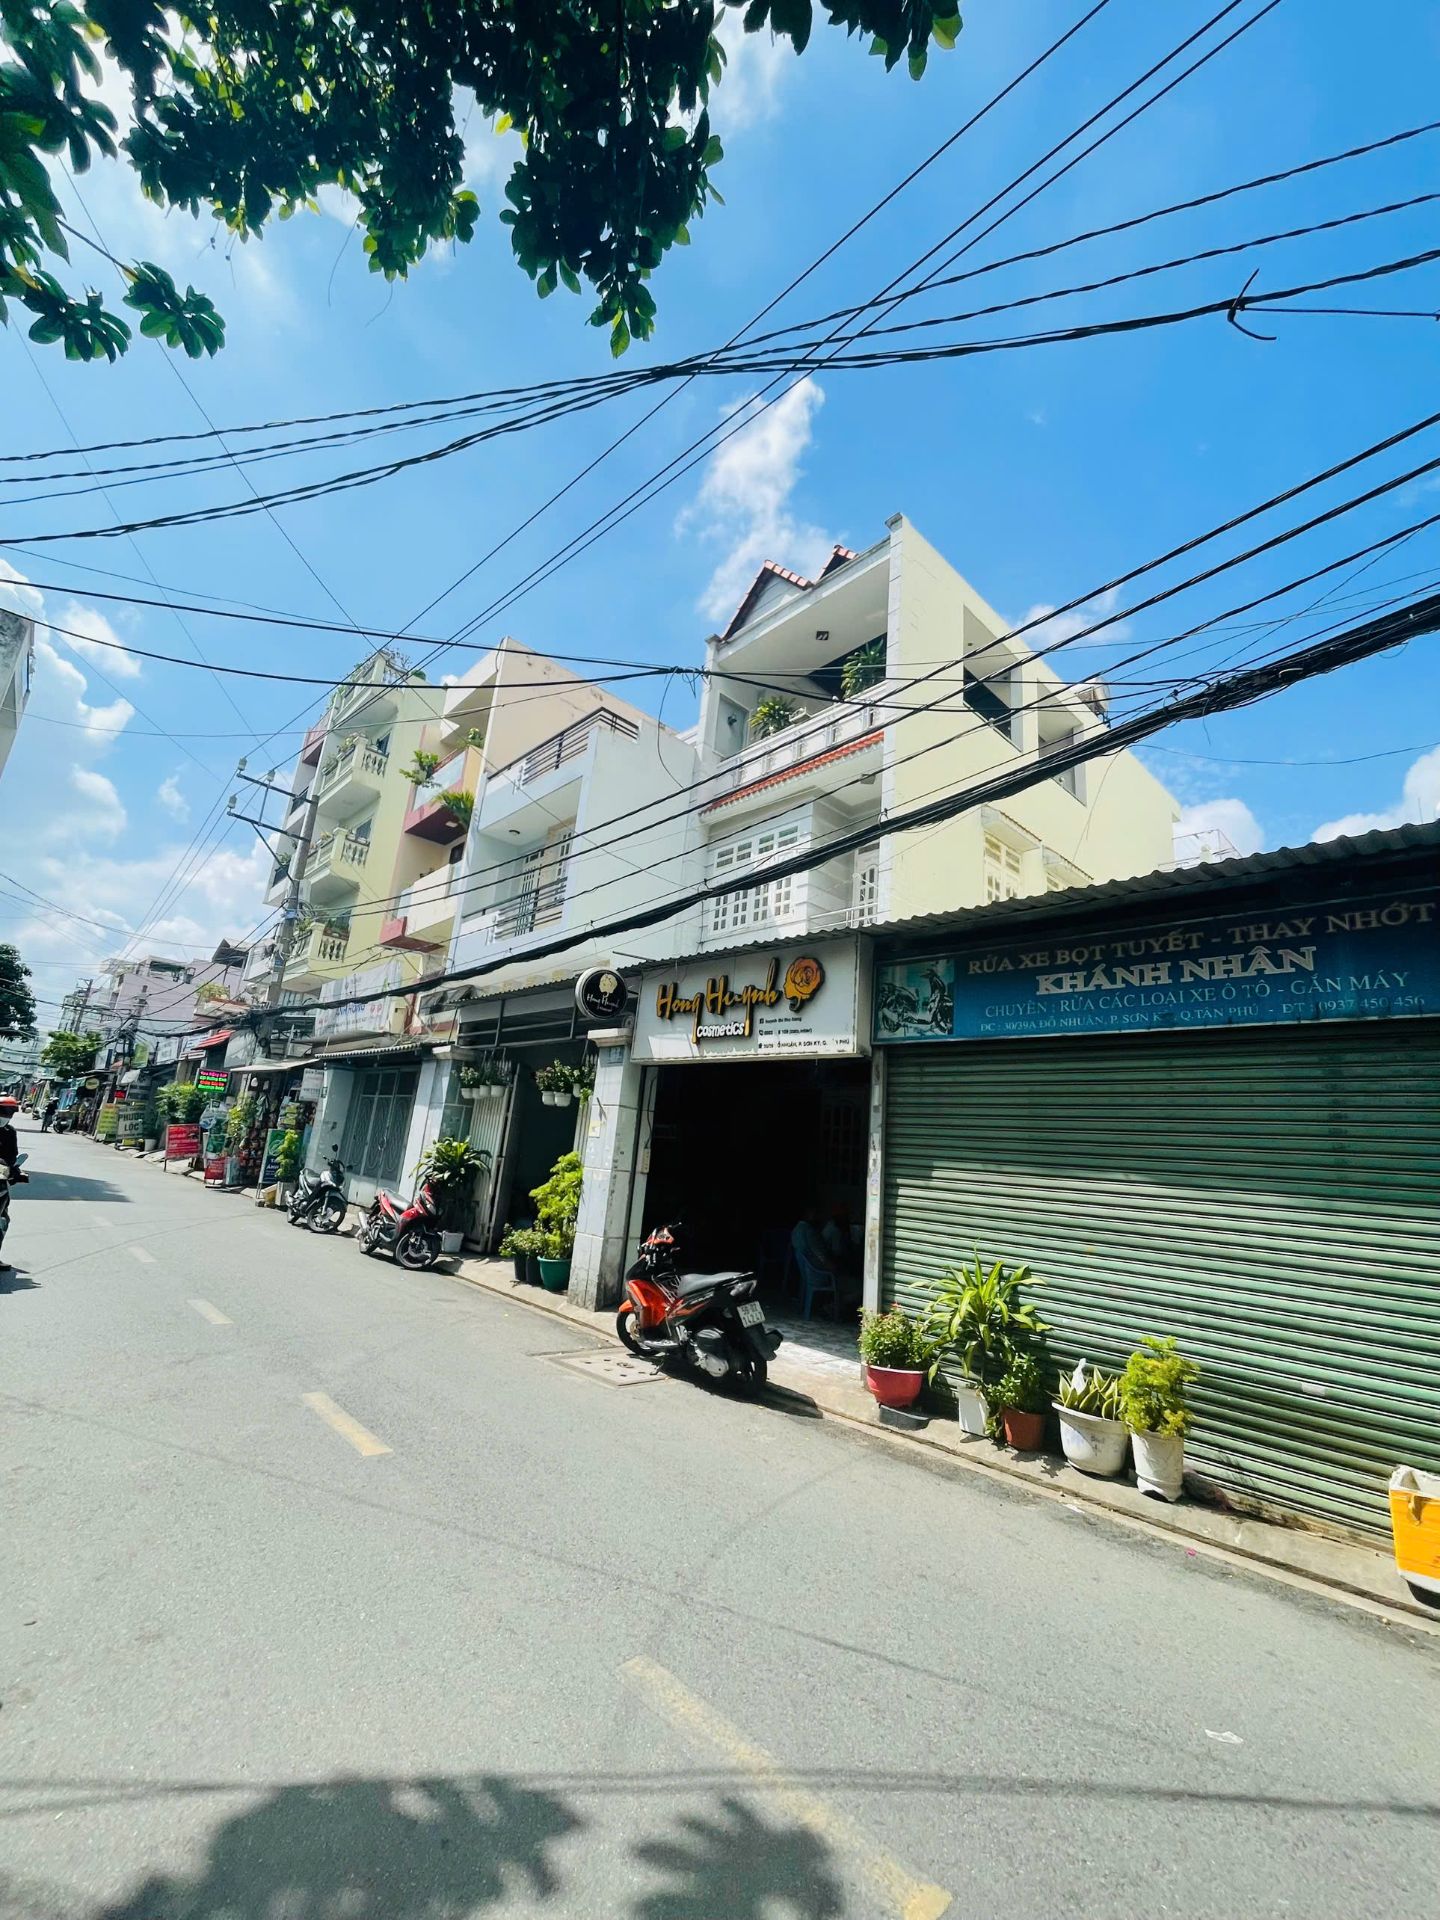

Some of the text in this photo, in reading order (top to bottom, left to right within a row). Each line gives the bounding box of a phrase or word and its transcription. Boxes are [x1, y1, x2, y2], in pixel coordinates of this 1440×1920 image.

[1019, 952, 1051, 969] XE
[1055, 945, 1107, 966] BỌT
[1110, 928, 1204, 958] TUYẾT
[1227, 916, 1317, 945] THAY
[1324, 901, 1437, 933] NHỚT
[985, 1000, 1048, 1018] CHUYÊN
[1060, 994, 1094, 1013] RỬA
[1099, 991, 1136, 1009] CÁC
[1140, 989, 1184, 1007] LOẠI
[1190, 986, 1217, 1003] XE
[1222, 982, 1236, 1000] Ô
[1241, 979, 1271, 999] TÔ
[1350, 968, 1410, 992] MÁY
[1035, 945, 1317, 996] KHÁNH NHÂN
[696, 1021, 745, 1038] cosmetics
